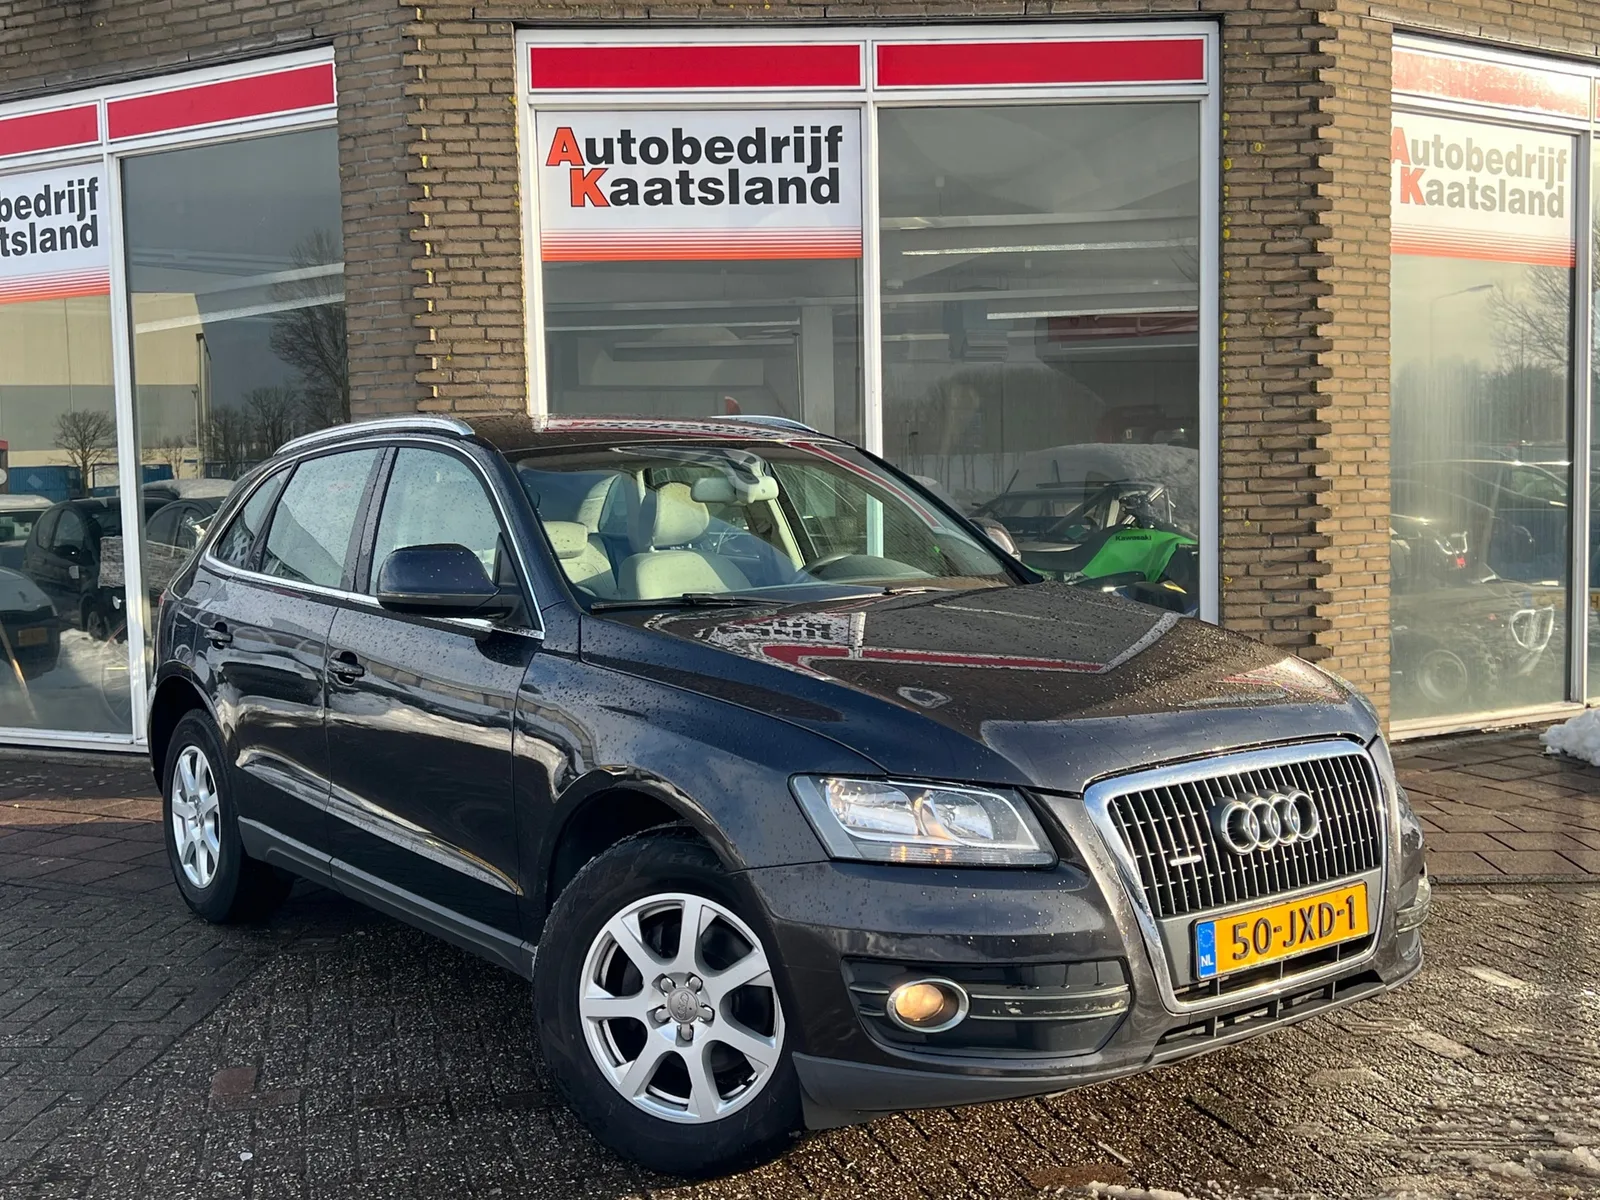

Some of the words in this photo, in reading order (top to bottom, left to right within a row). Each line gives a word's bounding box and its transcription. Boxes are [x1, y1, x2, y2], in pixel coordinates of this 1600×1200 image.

[546, 126, 843, 174] Autobedrijf
[1390, 123, 1568, 190] Autobedrijf
[569, 167, 840, 208] Kaatsland
[1399, 165, 1565, 219] Kaatsland
[1232, 895, 1356, 960] 50-JXD-1
[1200, 954, 1214, 967] NL
